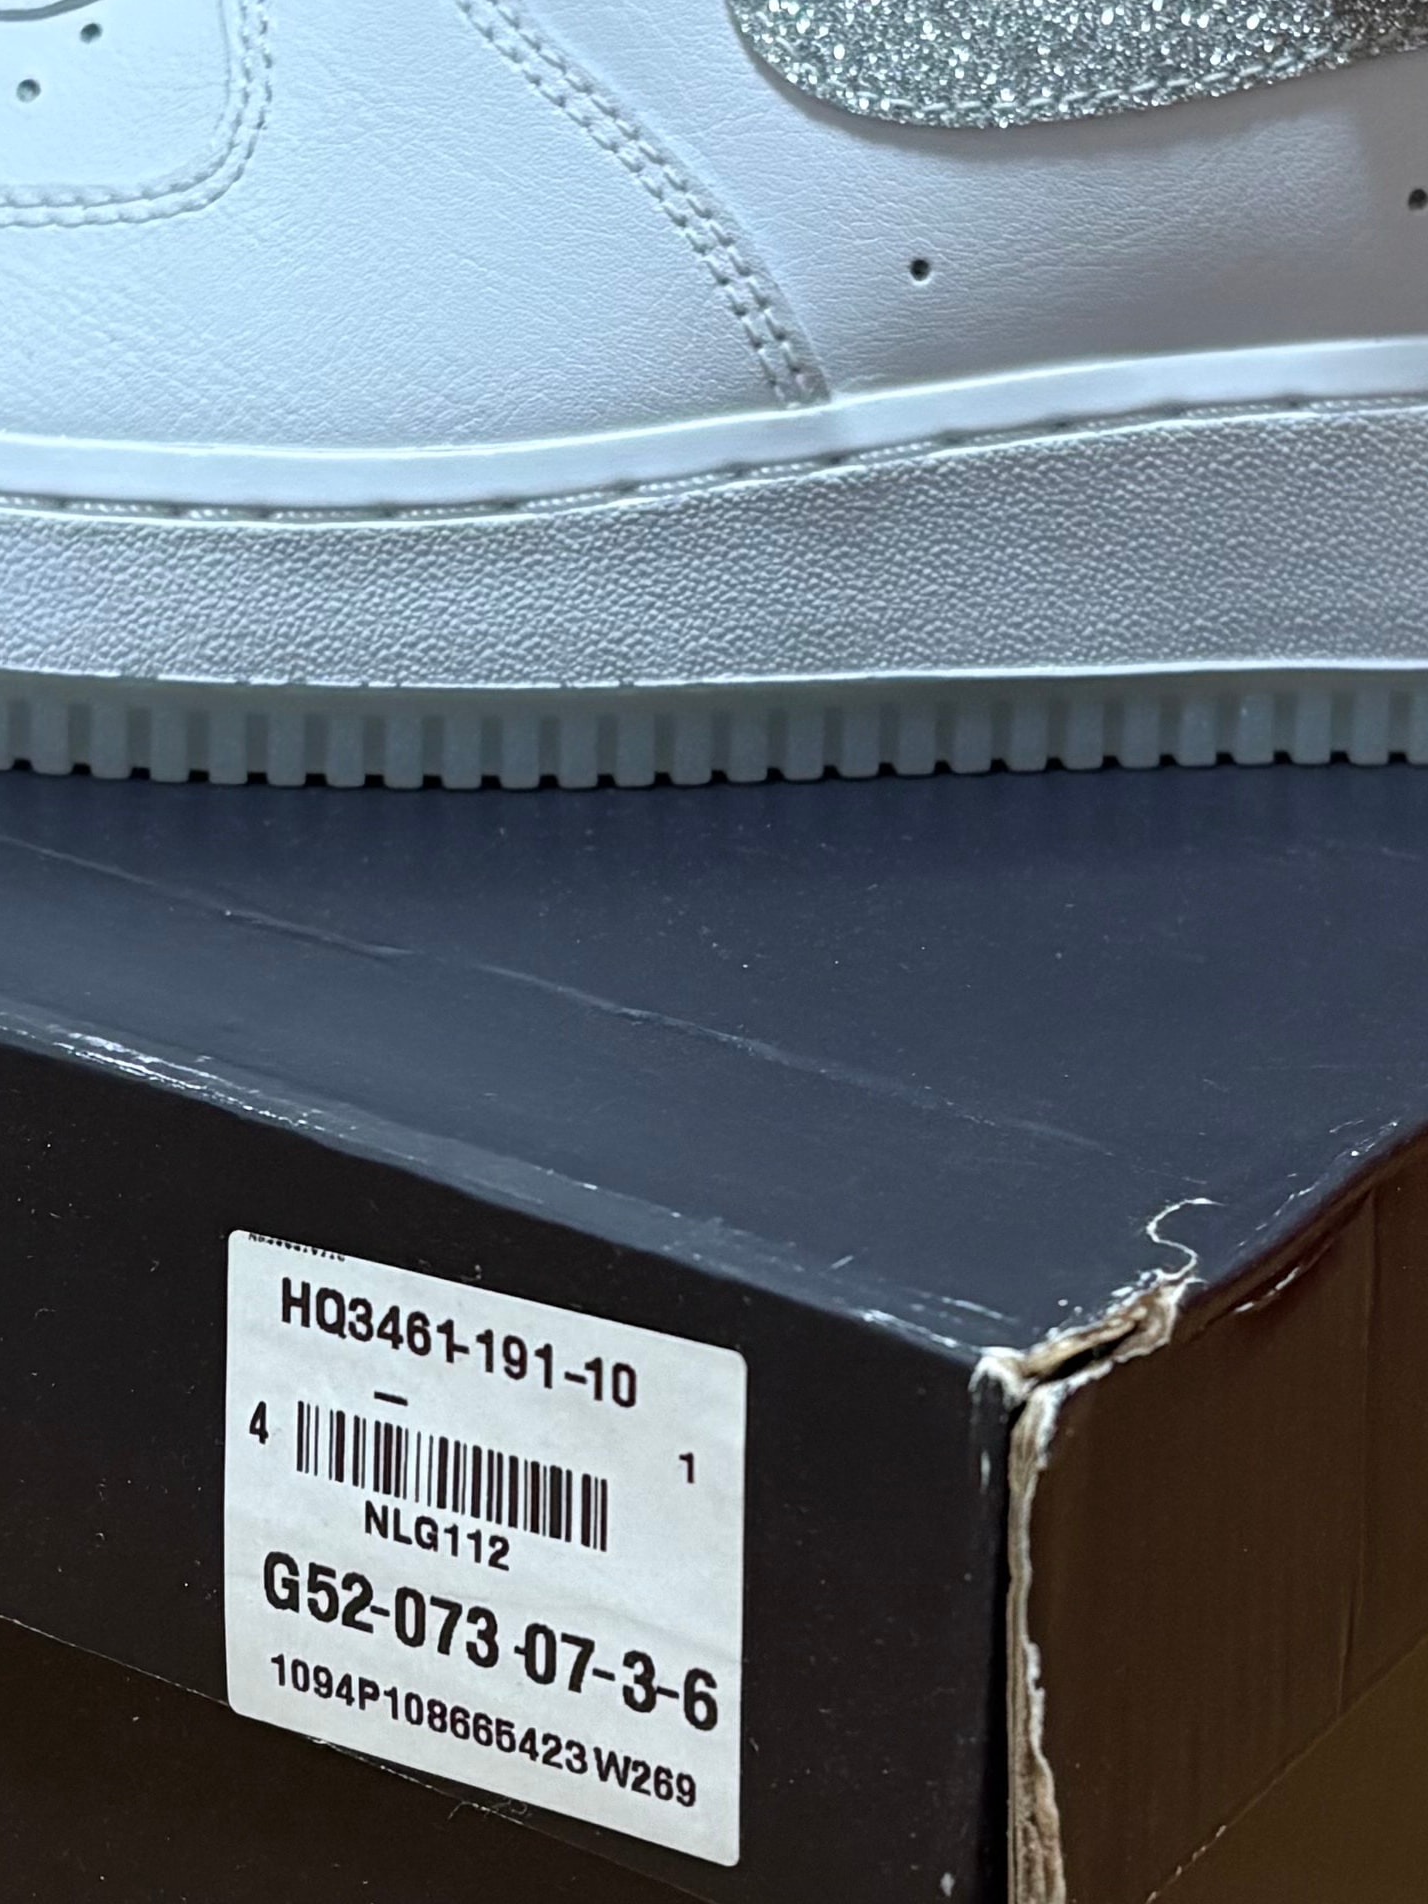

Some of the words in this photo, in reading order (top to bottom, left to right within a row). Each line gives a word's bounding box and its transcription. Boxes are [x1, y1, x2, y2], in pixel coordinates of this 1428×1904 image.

[281, 1276, 637, 1408] HQ3461-191-10
[248, 1400, 270, 1445] 4
[678, 1451, 696, 1485] 1
[364, 1500, 510, 1571] NLG112
